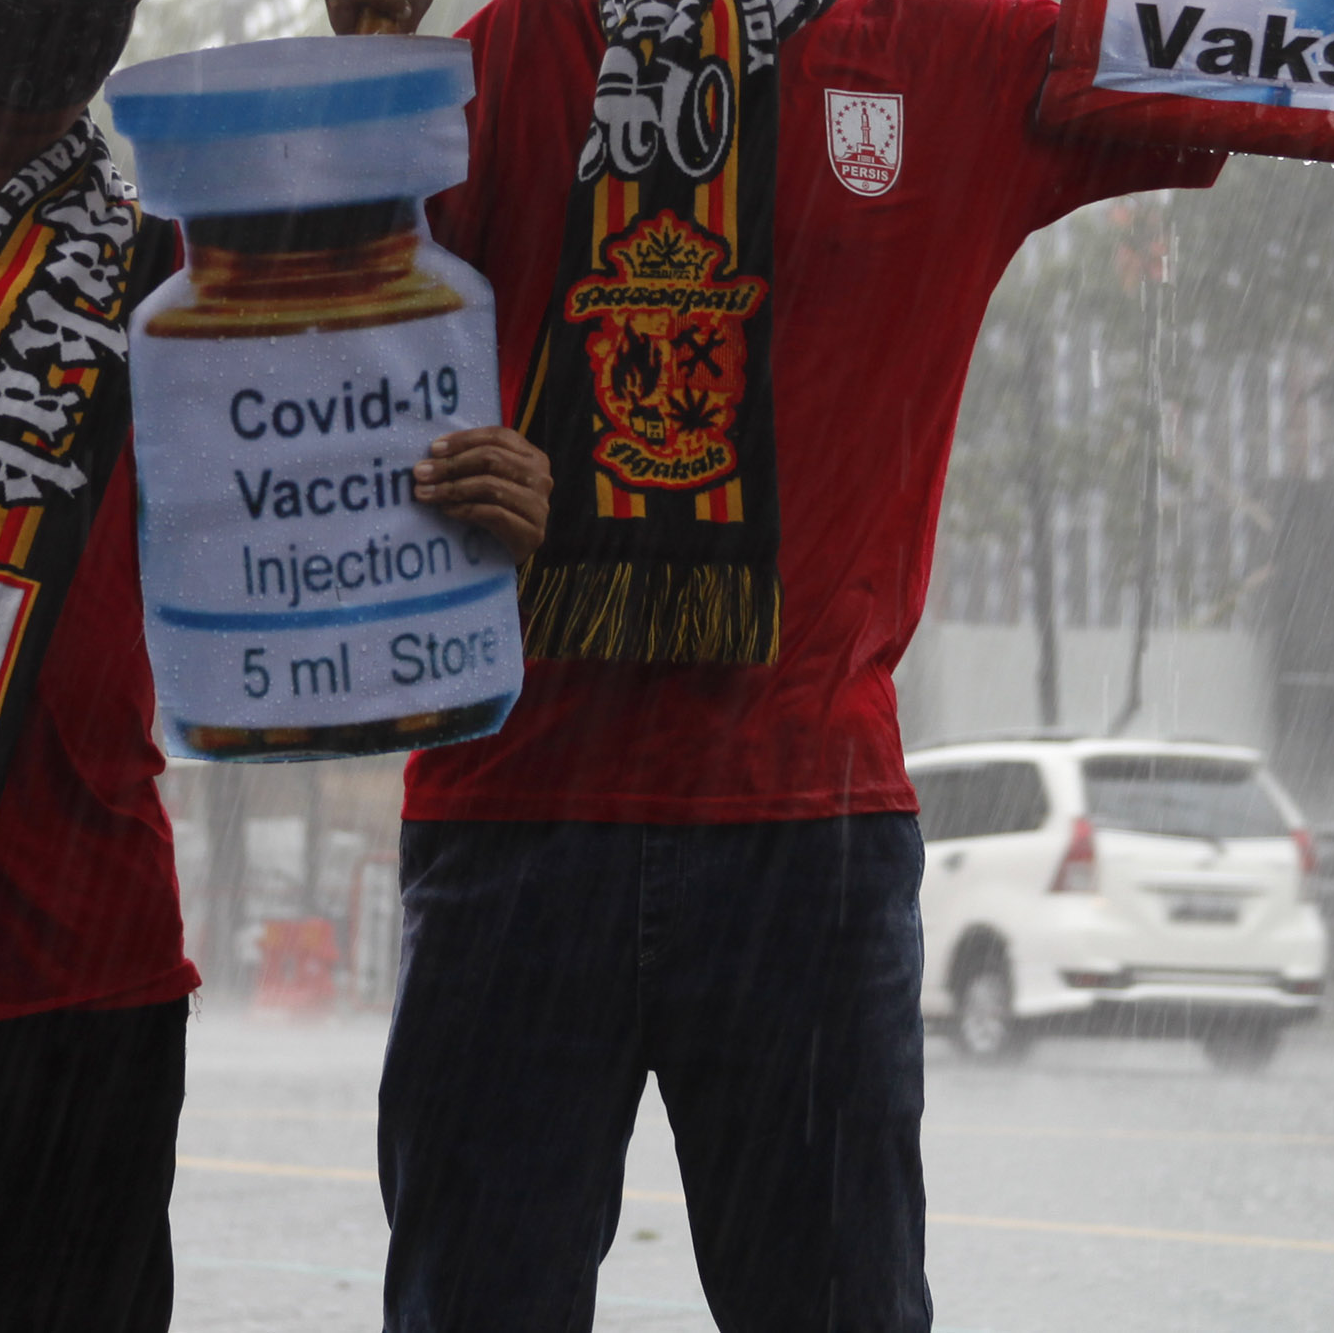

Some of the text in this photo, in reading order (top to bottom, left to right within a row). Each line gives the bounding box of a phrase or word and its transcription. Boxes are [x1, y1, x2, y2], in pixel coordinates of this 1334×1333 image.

[841, 164, 889, 182] PERSIS
[230, 365, 458, 439] Covid-19
[234, 457, 416, 519] Vaccin
[243, 535, 452, 609] Injection
[244, 648, 271, 699] 5
[291, 643, 352, 695] ml
